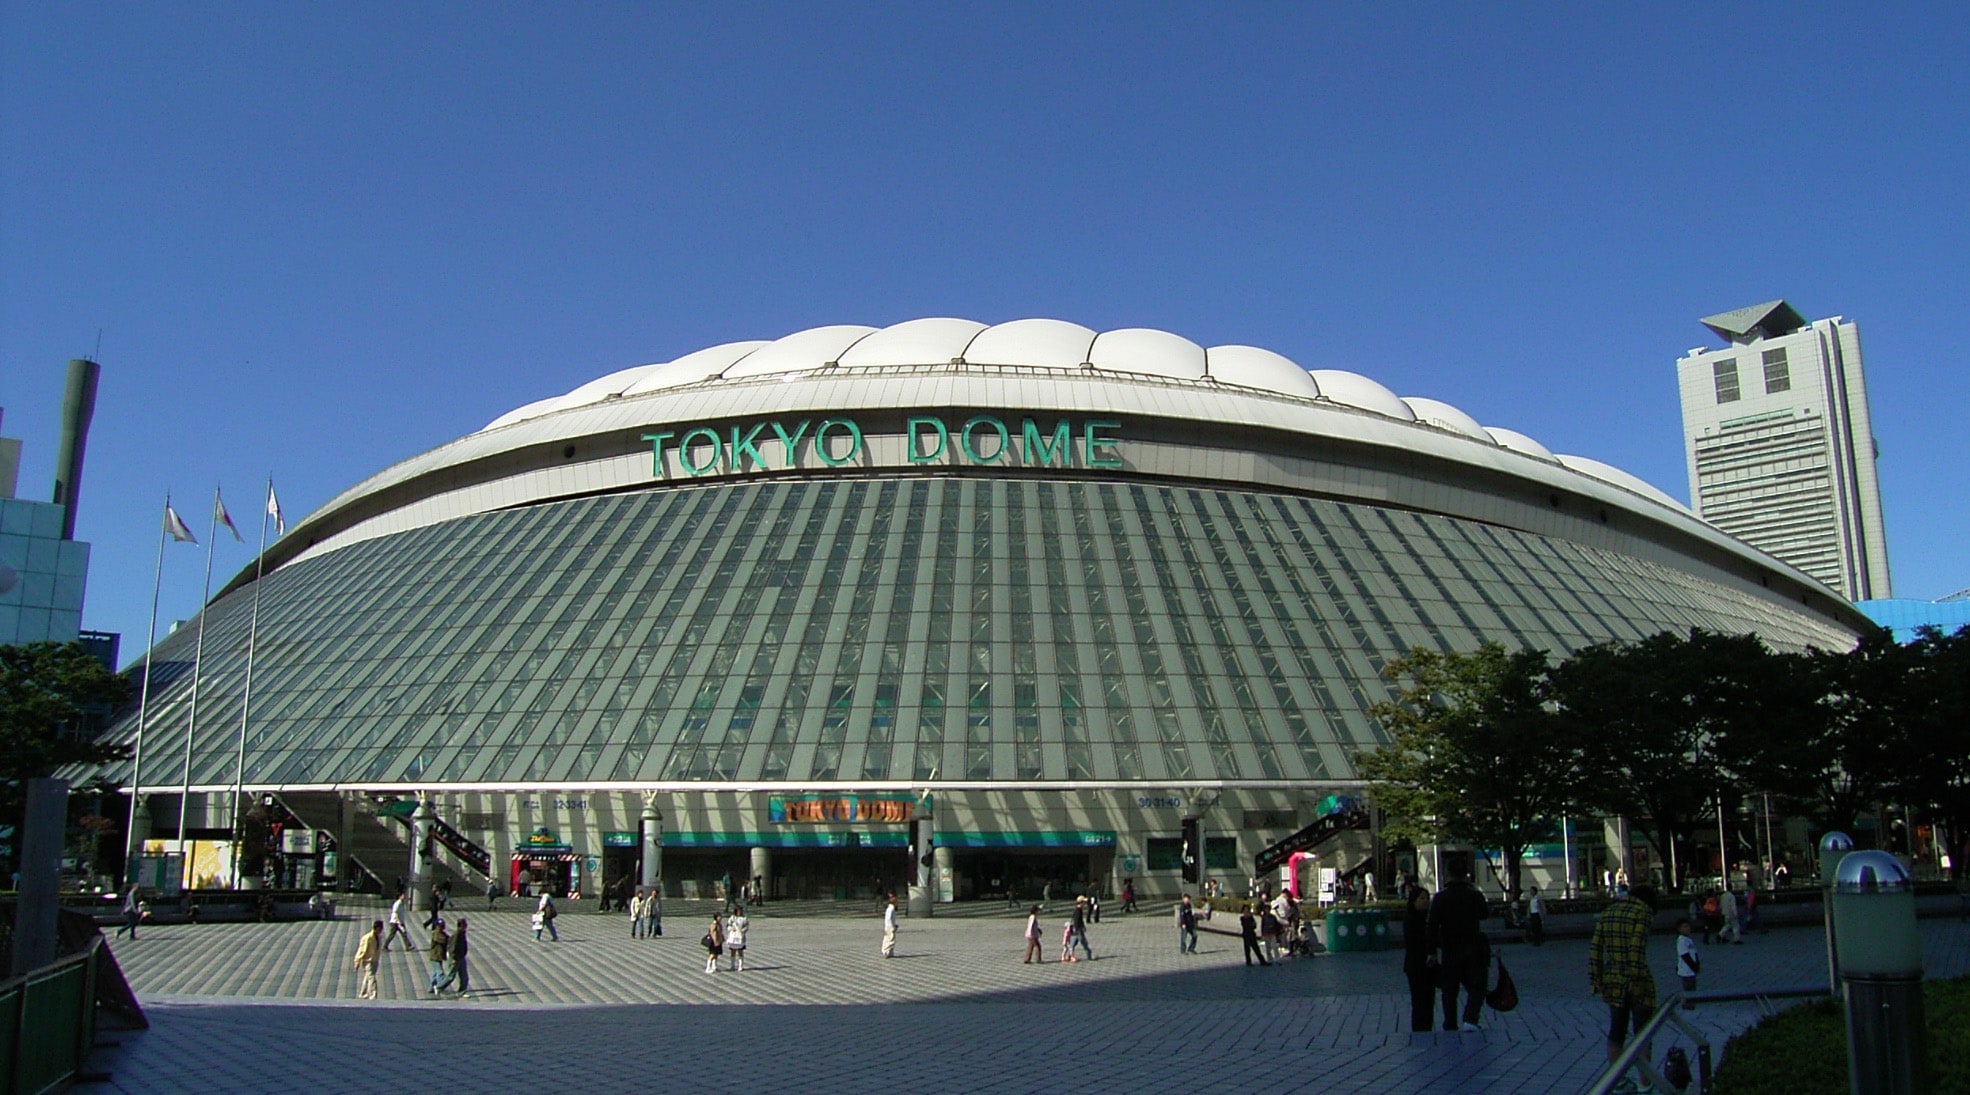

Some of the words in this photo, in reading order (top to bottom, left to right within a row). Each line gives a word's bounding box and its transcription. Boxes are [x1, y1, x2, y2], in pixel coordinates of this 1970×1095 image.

[641, 417, 861, 478] TOKYO
[907, 414, 1122, 467] DOME
[784, 799, 850, 822] TOKYO
